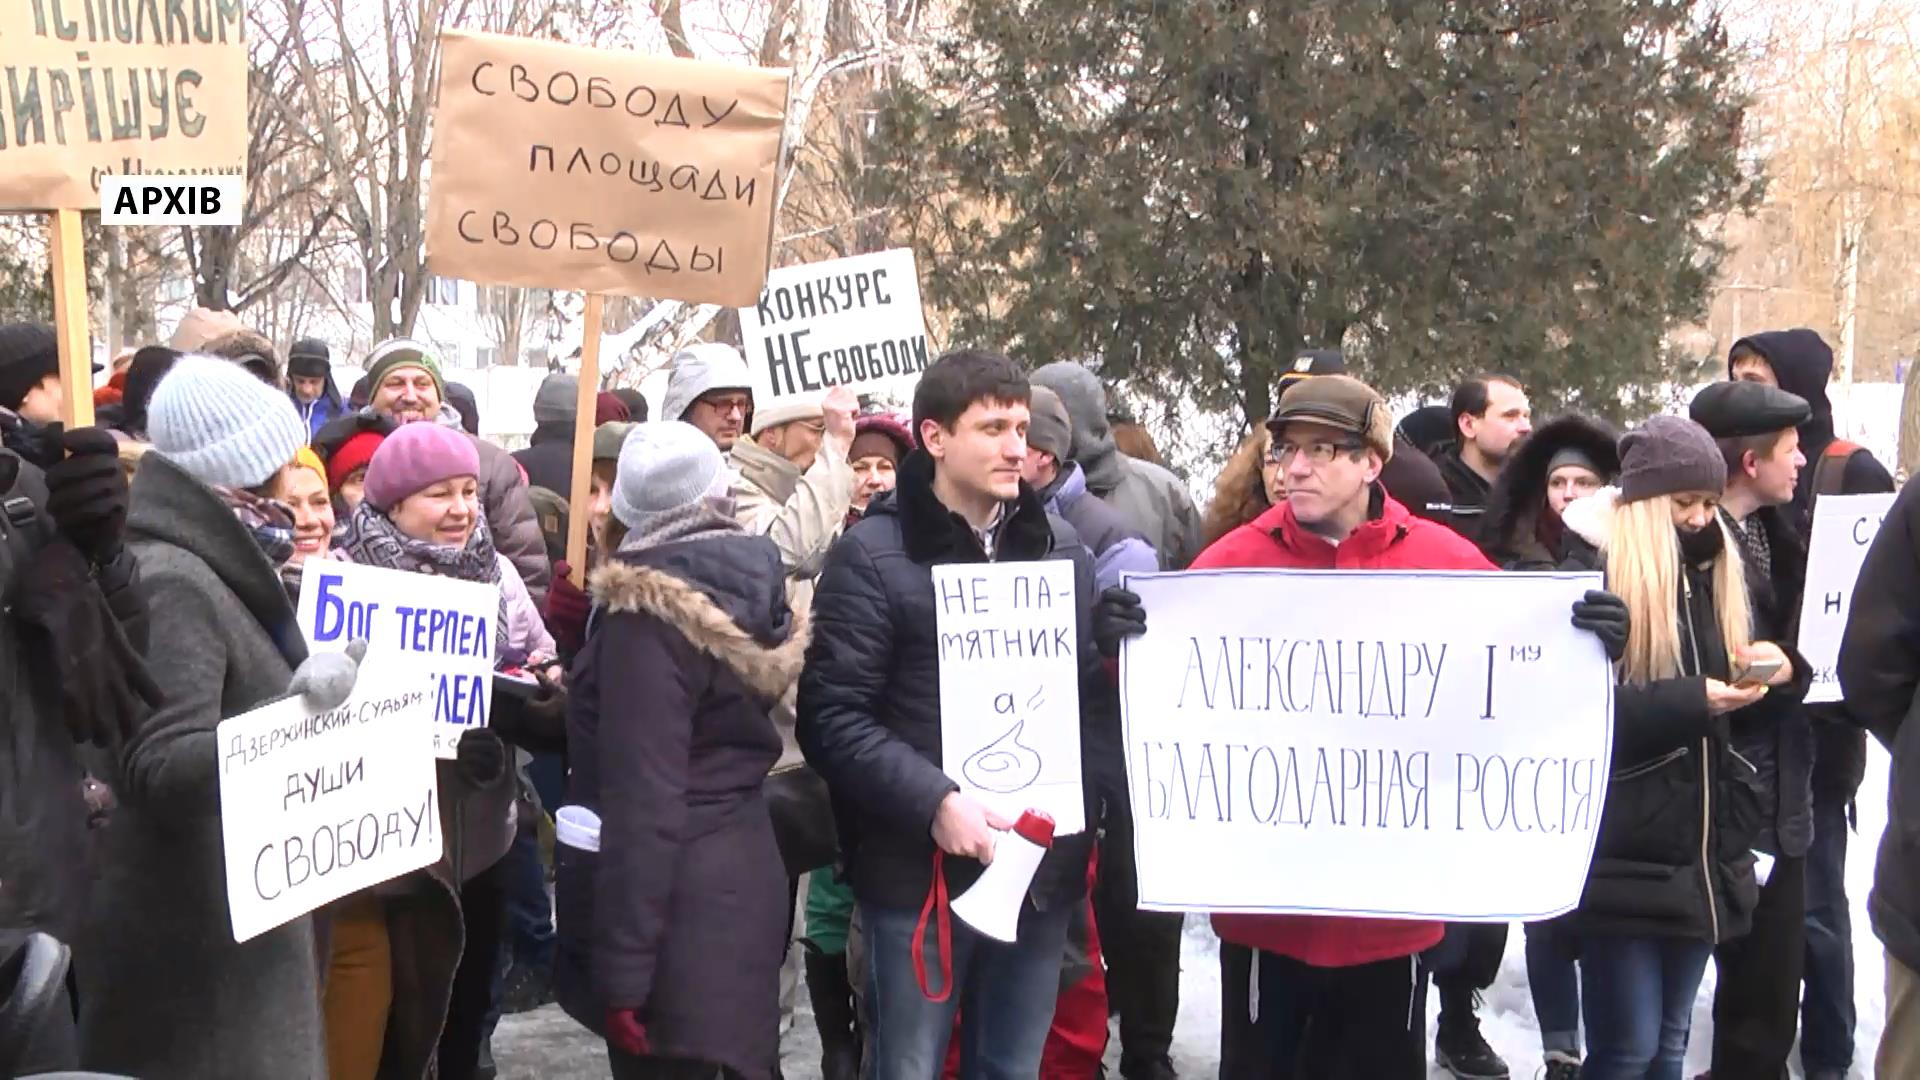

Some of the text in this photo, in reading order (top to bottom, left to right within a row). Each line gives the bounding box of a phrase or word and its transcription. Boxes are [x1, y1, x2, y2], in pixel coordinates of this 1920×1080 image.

[0, 51, 207, 149] ИРІШУЄ
[472, 61, 738, 129] СВОБОДУ
[458, 210, 723, 275] СВОБОДЫ
[757, 268, 892, 327] КОНКУРС
[941, 576, 1071, 615] НЕ ПА-
[396, 606, 488, 659] ТЕРПЕЛ
[941, 627, 1072, 661] МЯТНИК
[1177, 637, 1447, 719] АЛЕКСАНДРУ
[284, 756, 364, 811] ДУШИ
[1144, 742, 1429, 830] БЛАГОДАРНАЯ
[254, 789, 433, 901] СВОБОДУ!
